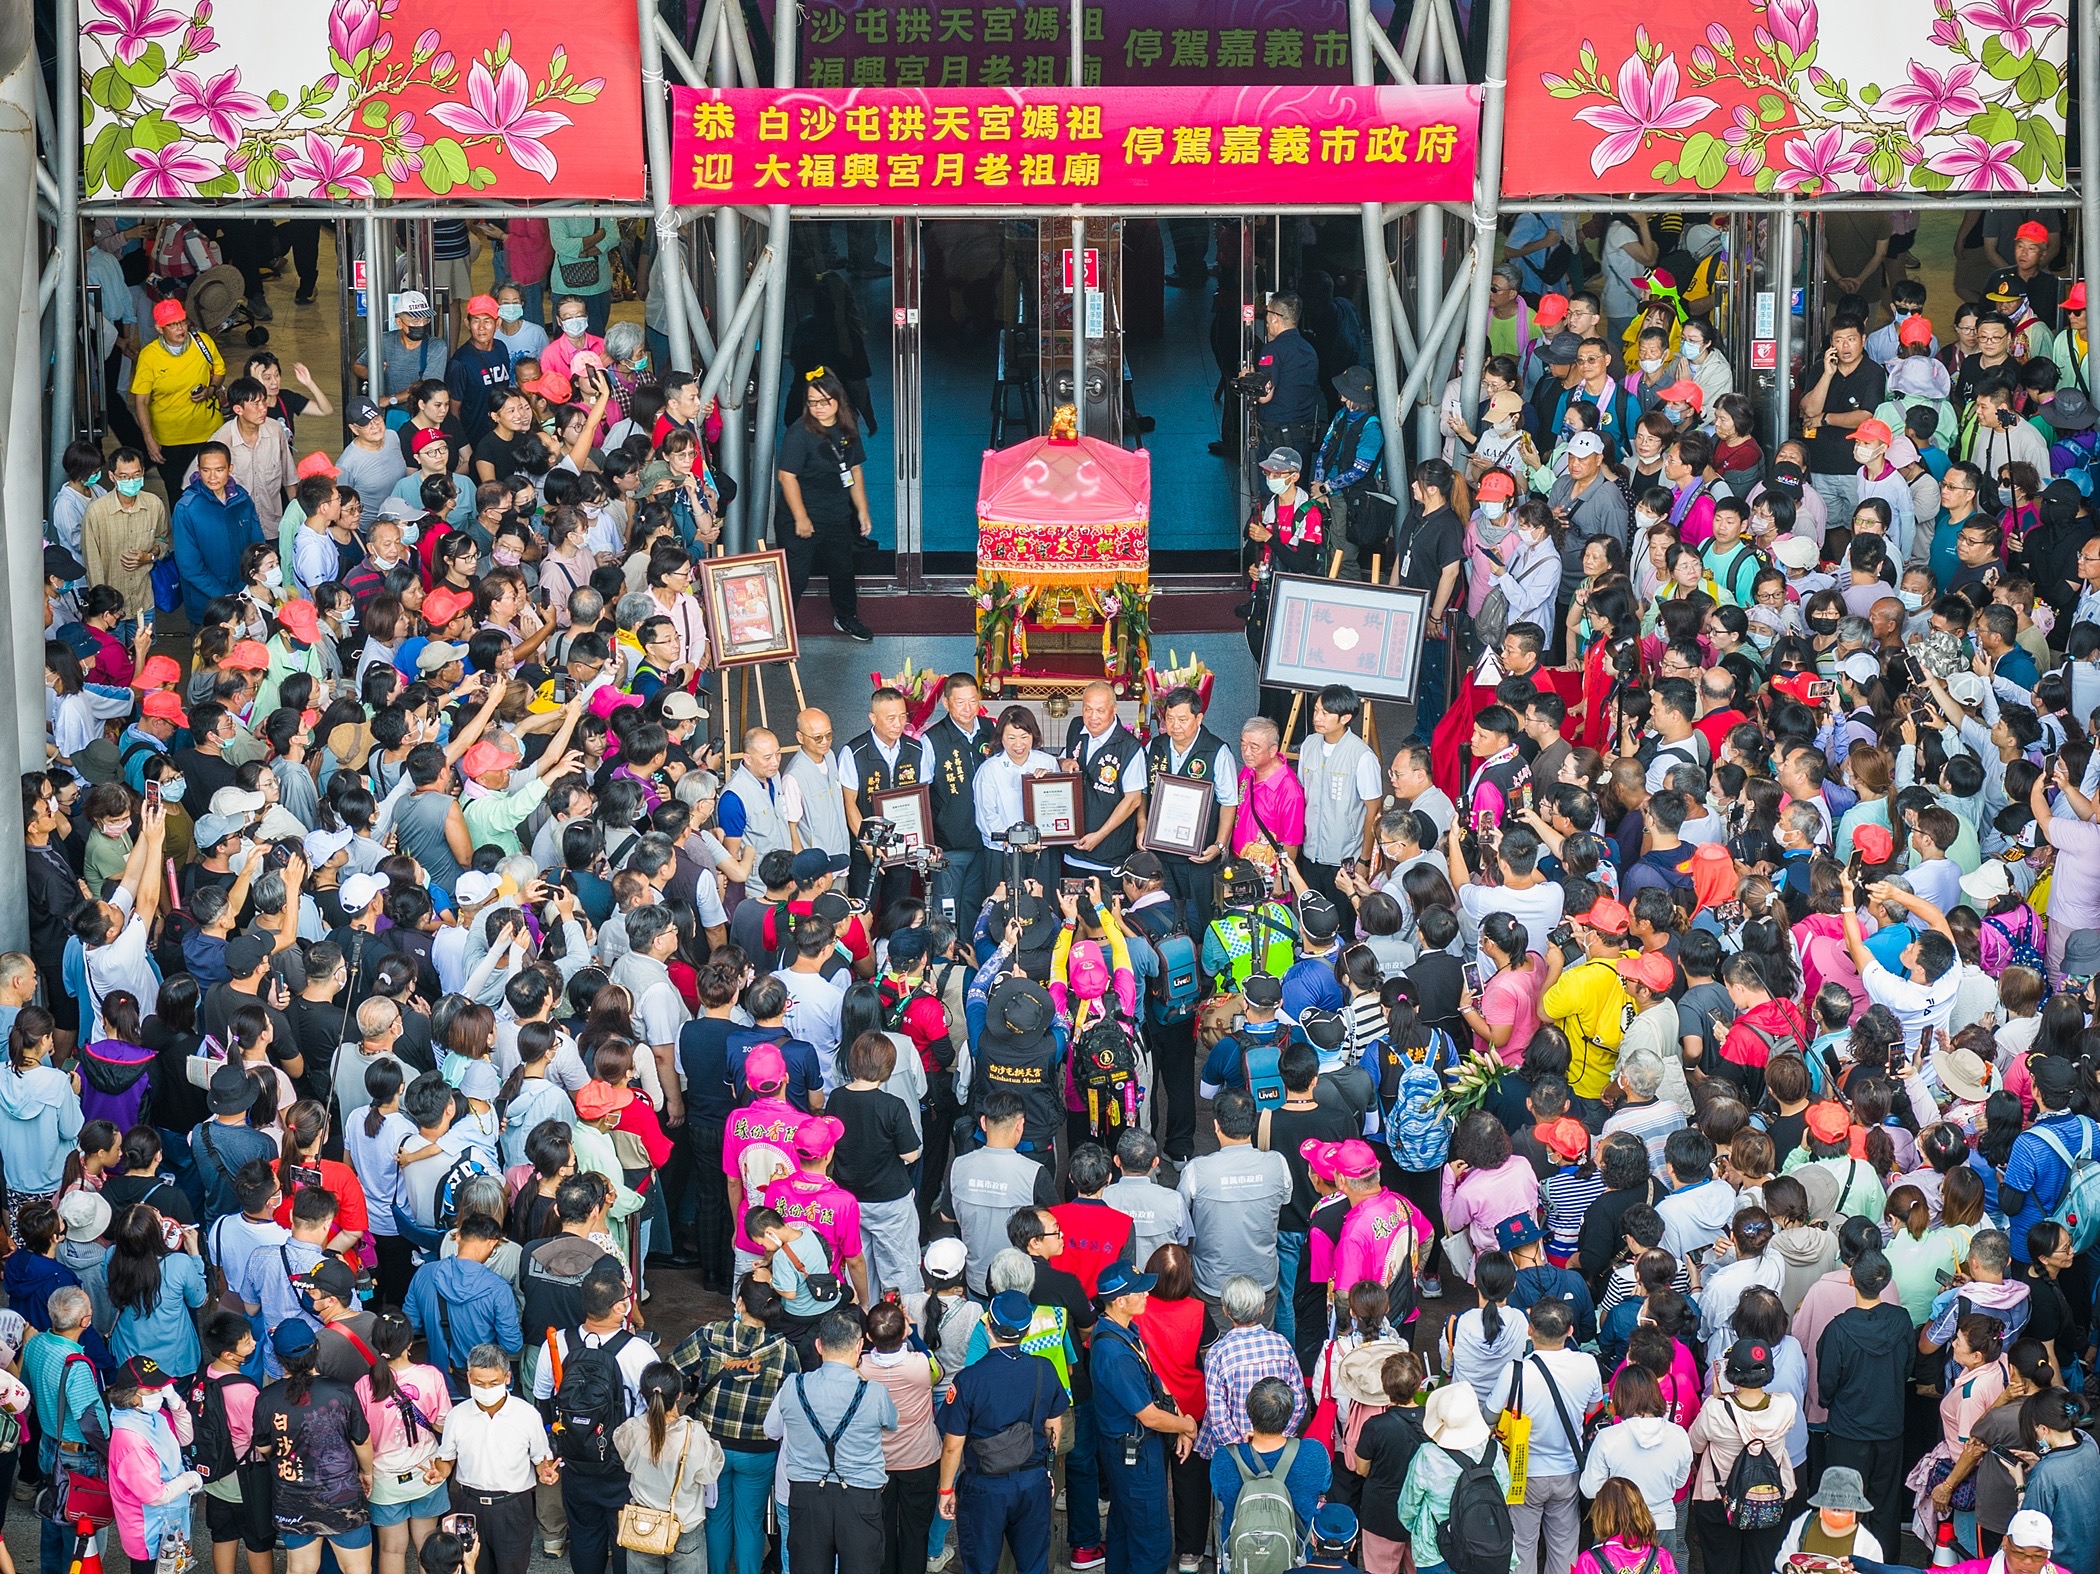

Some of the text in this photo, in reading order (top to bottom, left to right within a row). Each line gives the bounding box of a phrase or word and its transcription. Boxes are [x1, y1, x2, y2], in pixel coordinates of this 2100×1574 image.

[771, 7, 1105, 44] 沙屯拱天宮媽祖
[1122, 28, 1349, 69] 停駕嘉義市
[808, 54, 1103, 87] 福興宮月老祖廟
[757, 104, 1103, 141] 白沙屯拱天宮媽祖
[1121, 123, 1459, 165] 停駕嘉義市政府
[753, 152, 1101, 189] 大福興宮月老祖廟
[1174, 976, 1192, 988] LiveU
[989, 1064, 1042, 1078] 白沙屯拱天宮
[1258, 1089, 1279, 1100] LiveU
[273, 1412, 298, 1482] 白沙屯
